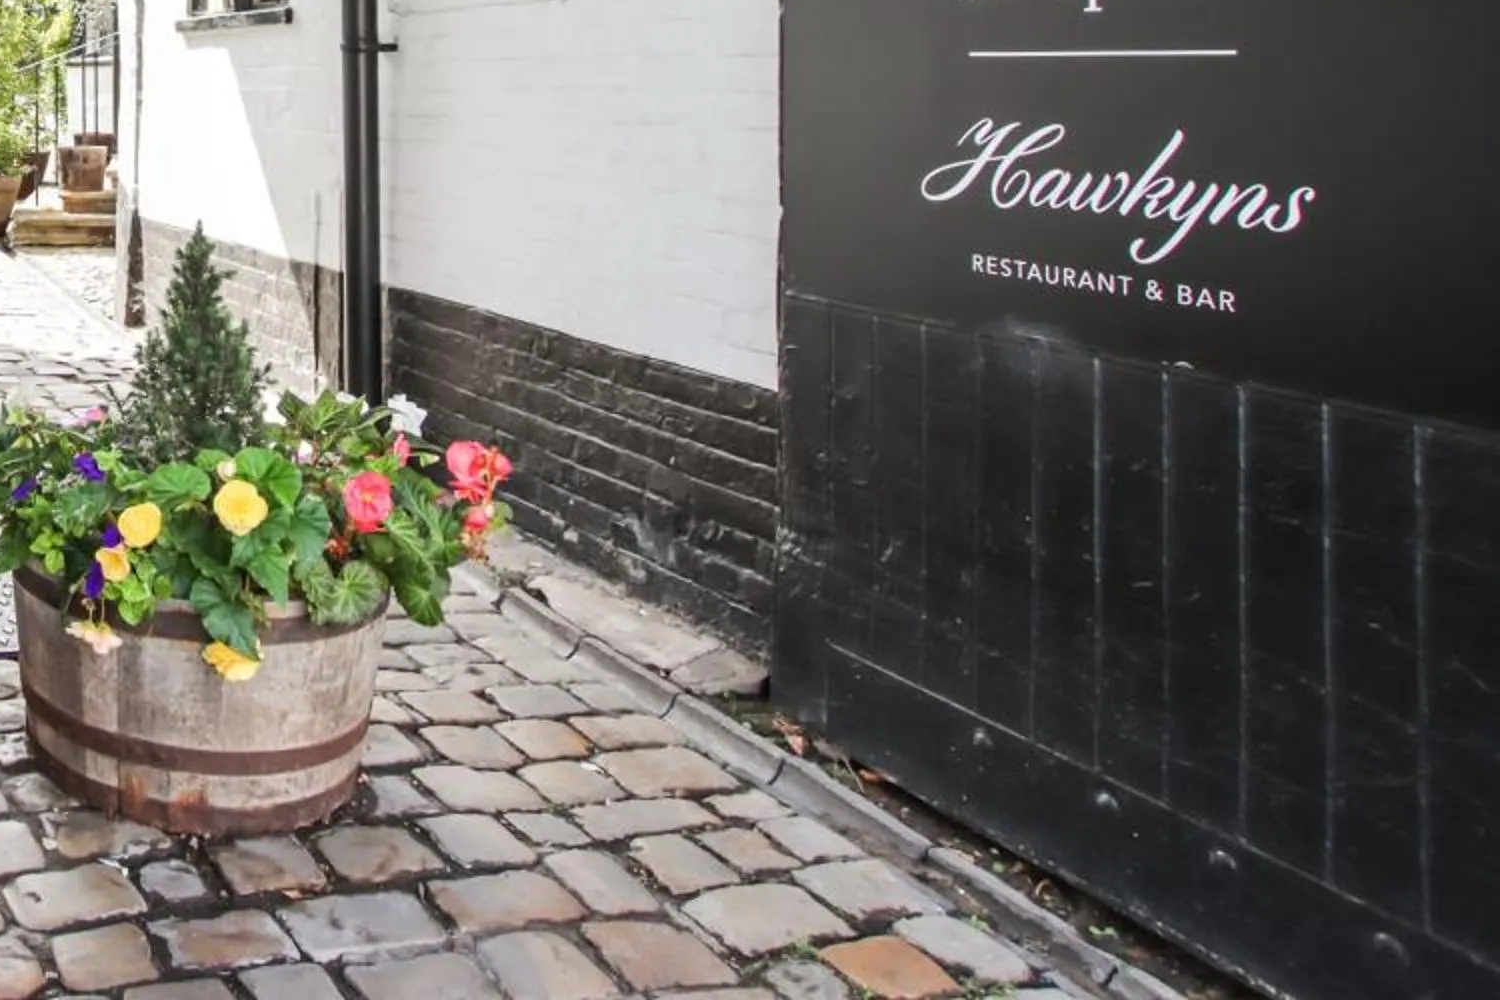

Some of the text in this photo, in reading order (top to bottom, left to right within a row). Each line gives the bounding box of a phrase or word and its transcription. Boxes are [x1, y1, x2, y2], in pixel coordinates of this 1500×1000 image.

[920, 117, 1316, 265] Hawkyns
[971, 253, 1236, 313] RESTAURANT & BAR
